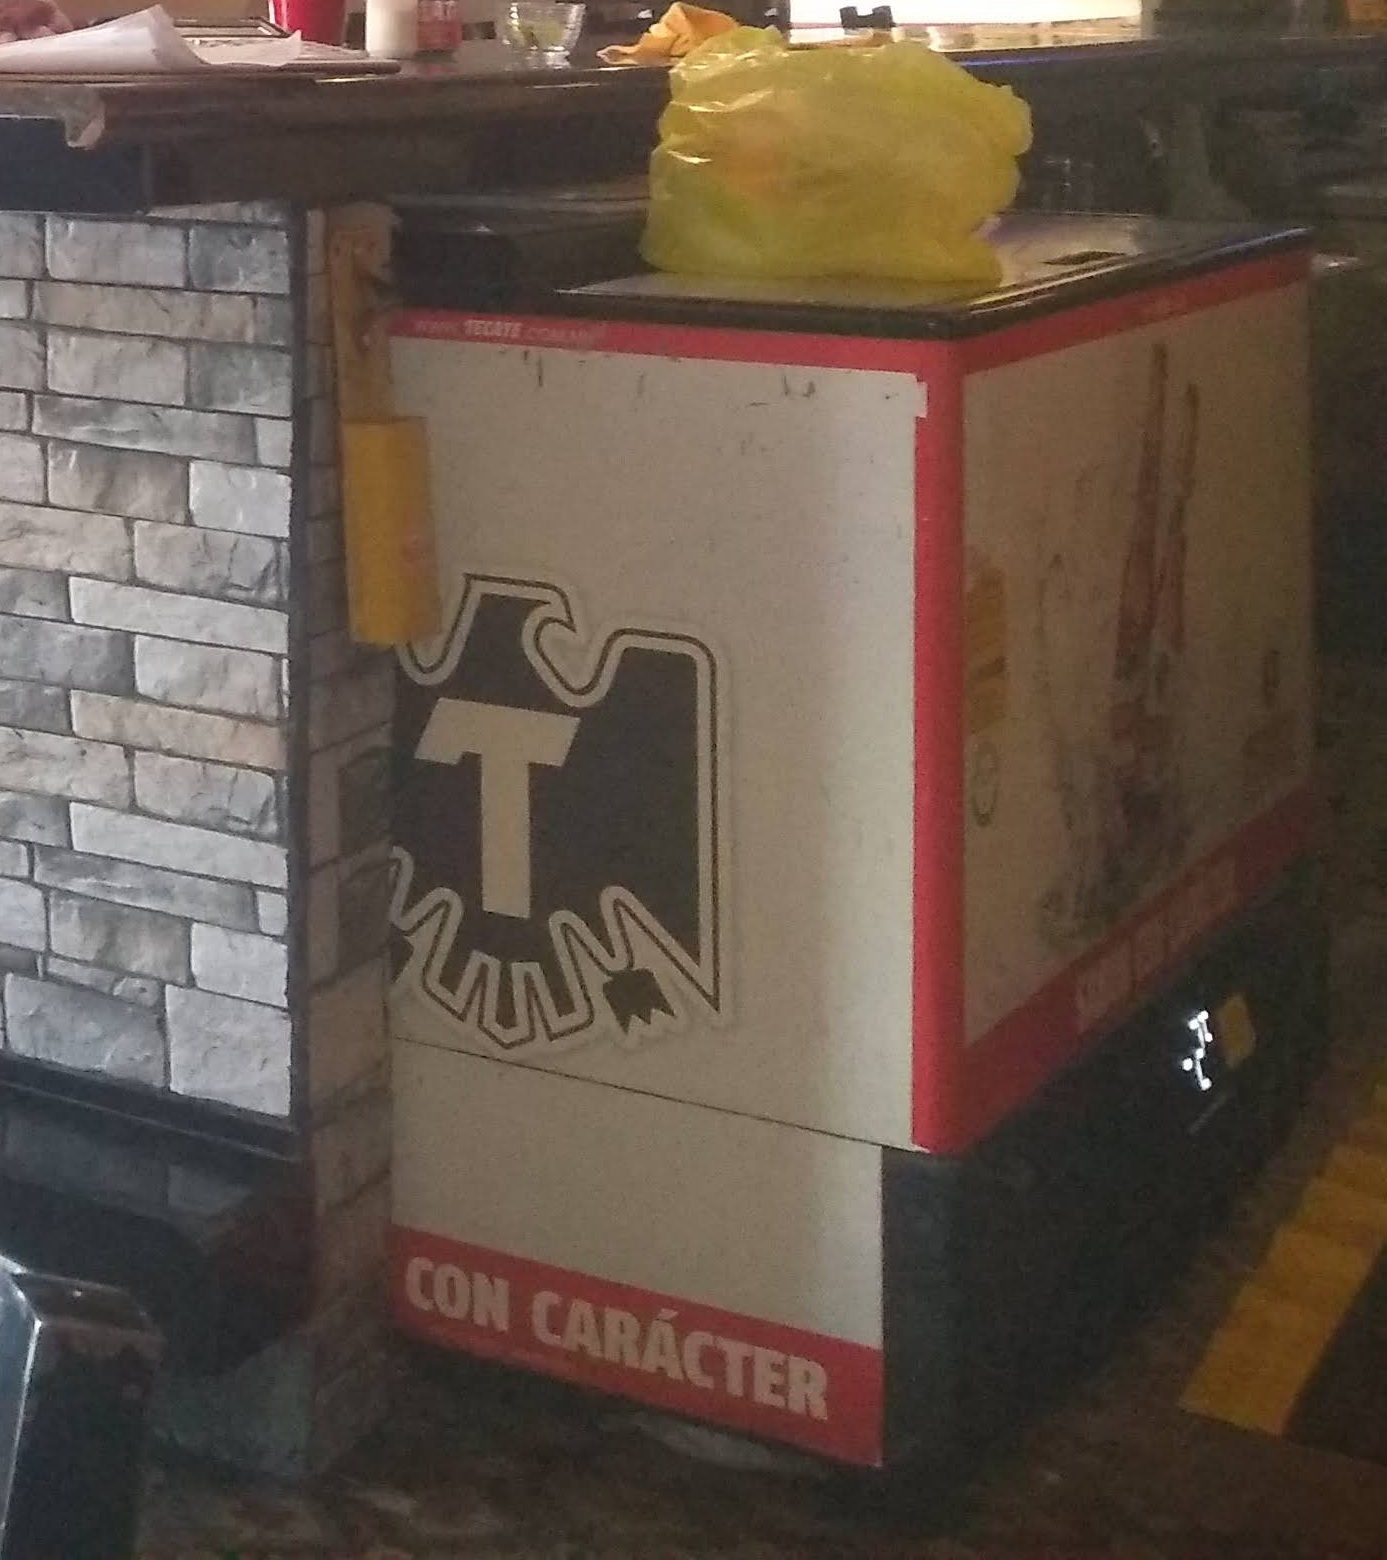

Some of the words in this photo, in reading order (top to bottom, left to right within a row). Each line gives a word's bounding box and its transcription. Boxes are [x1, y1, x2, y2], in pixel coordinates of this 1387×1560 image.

[414, 697, 581, 919] T
[405, 1256, 509, 1332] CON
[531, 1290, 828, 1421] CARÁCTER
